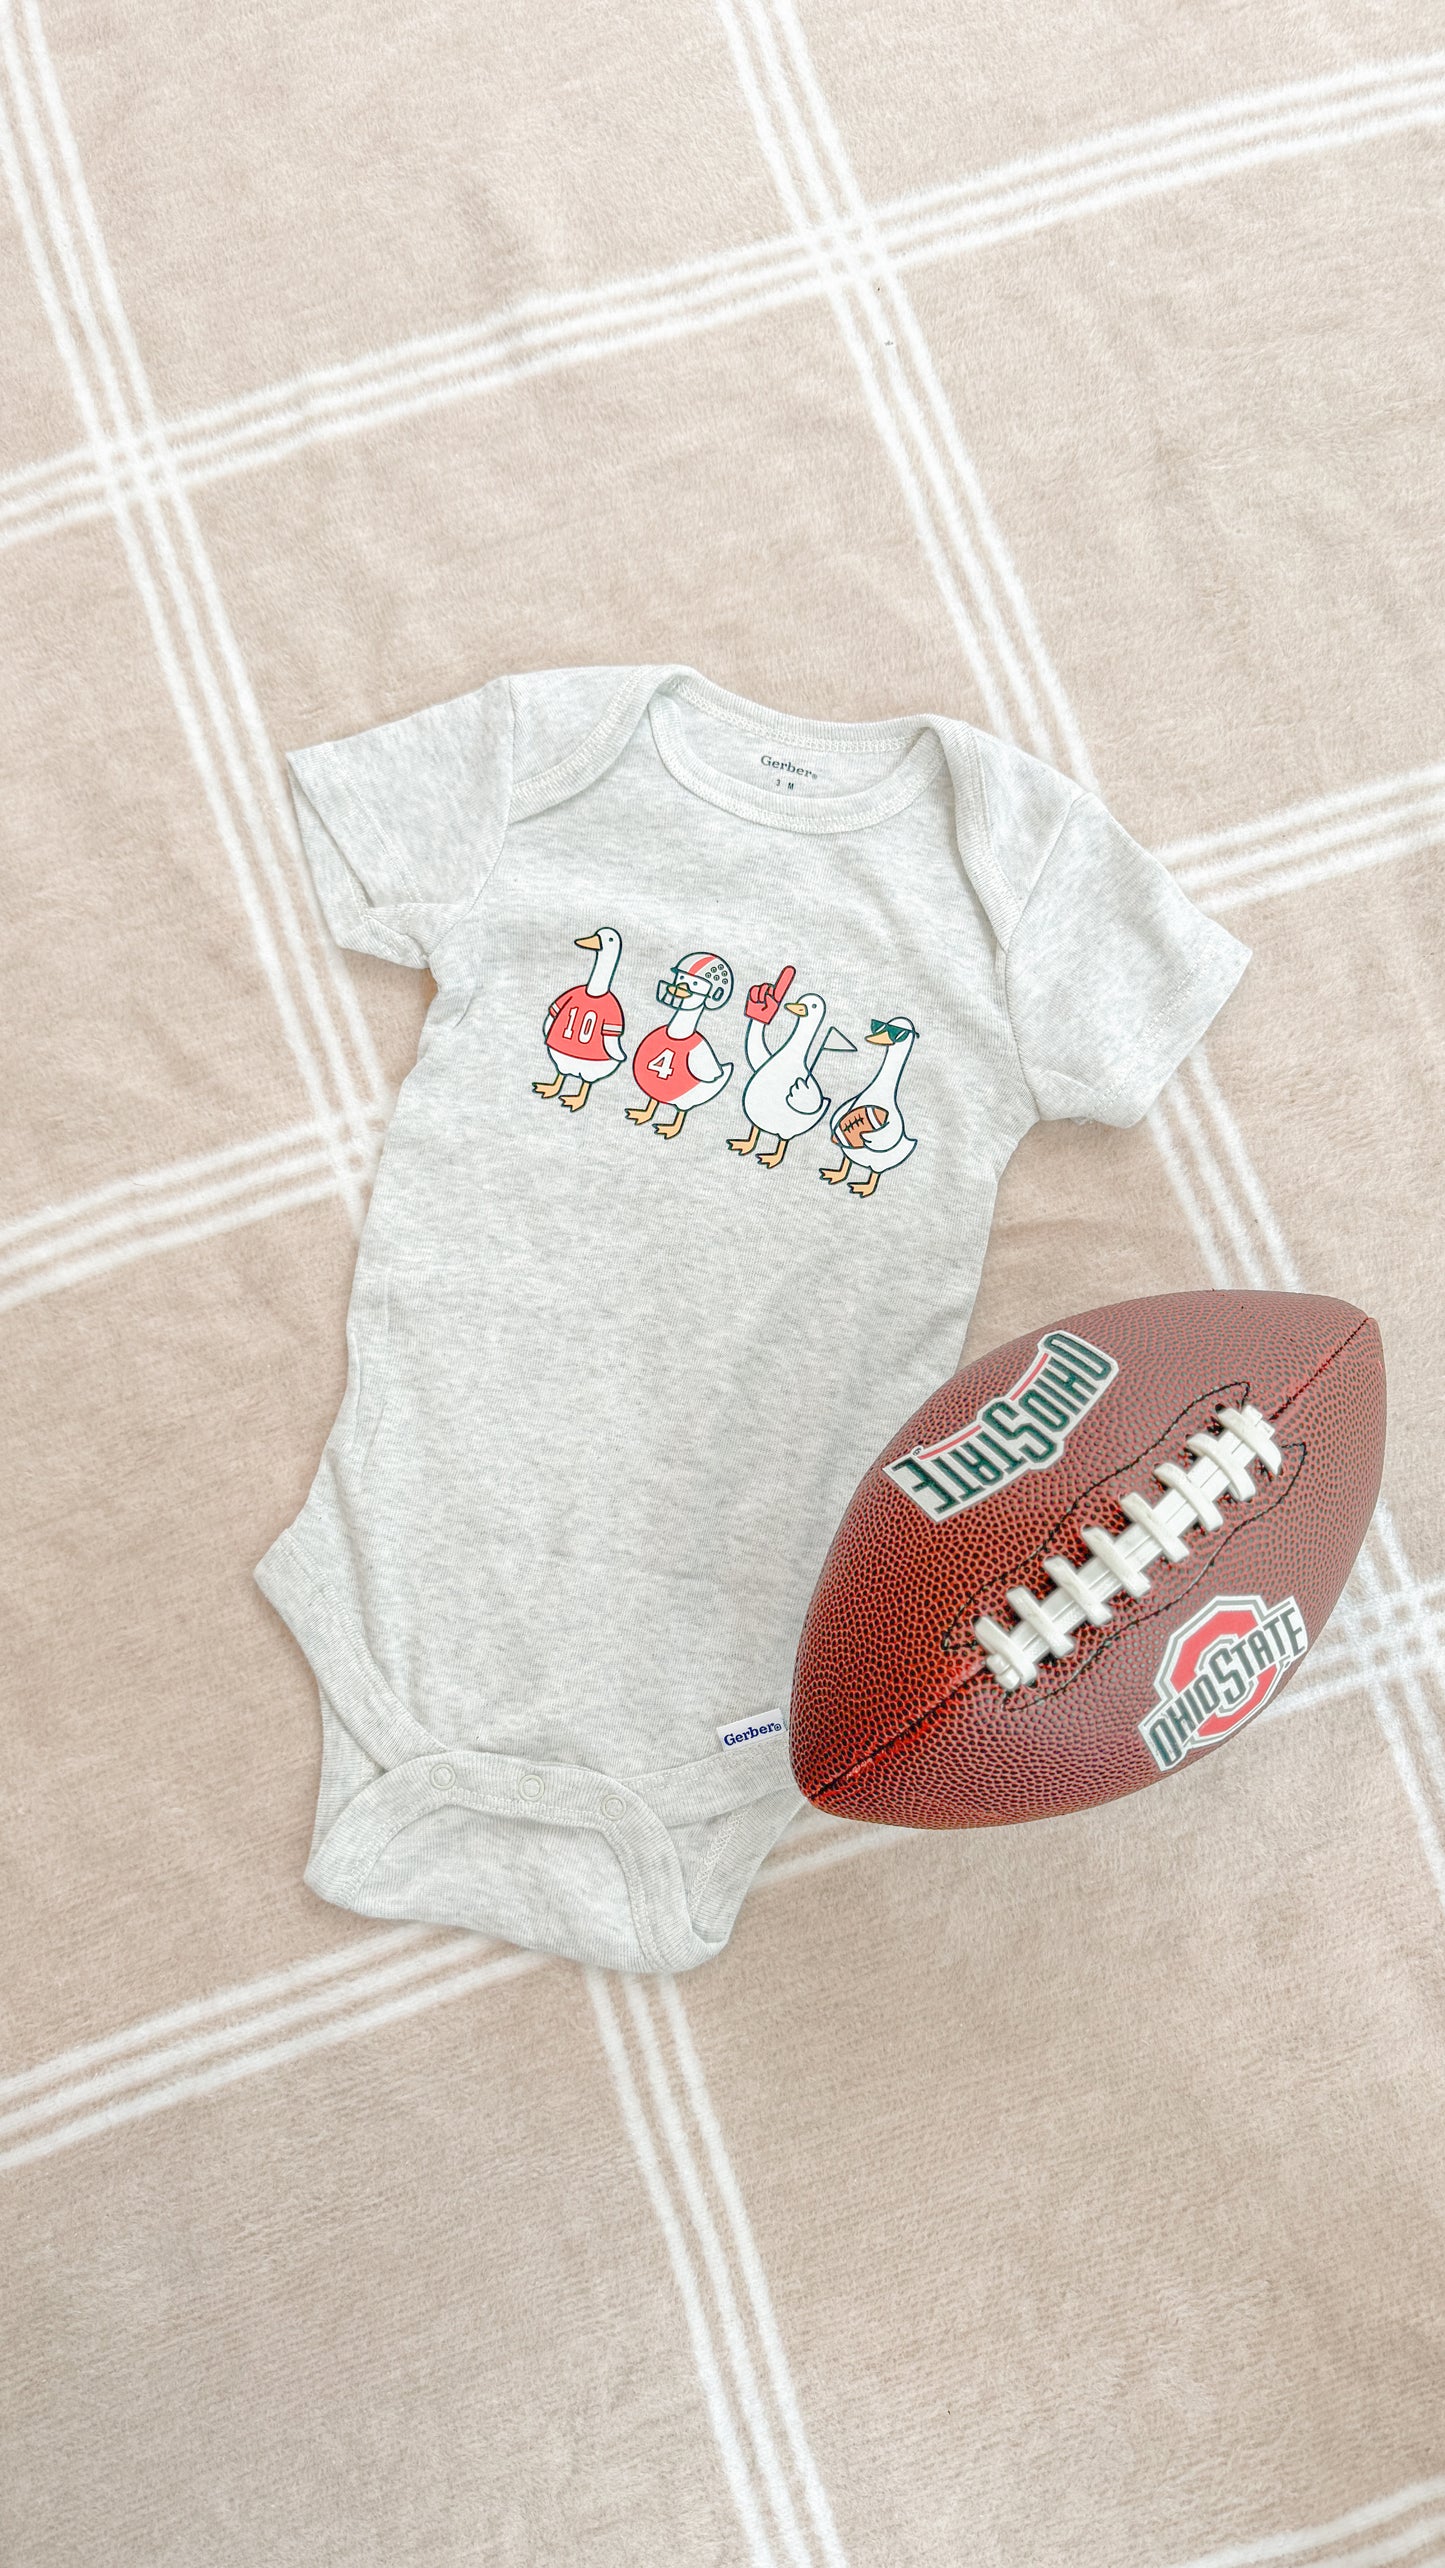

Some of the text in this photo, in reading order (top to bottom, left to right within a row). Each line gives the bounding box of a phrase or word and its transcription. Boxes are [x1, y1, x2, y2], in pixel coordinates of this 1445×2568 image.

[787, 782, 794, 790] M
[562, 1007, 598, 1044] 10
[647, 1048, 676, 1080] 4
